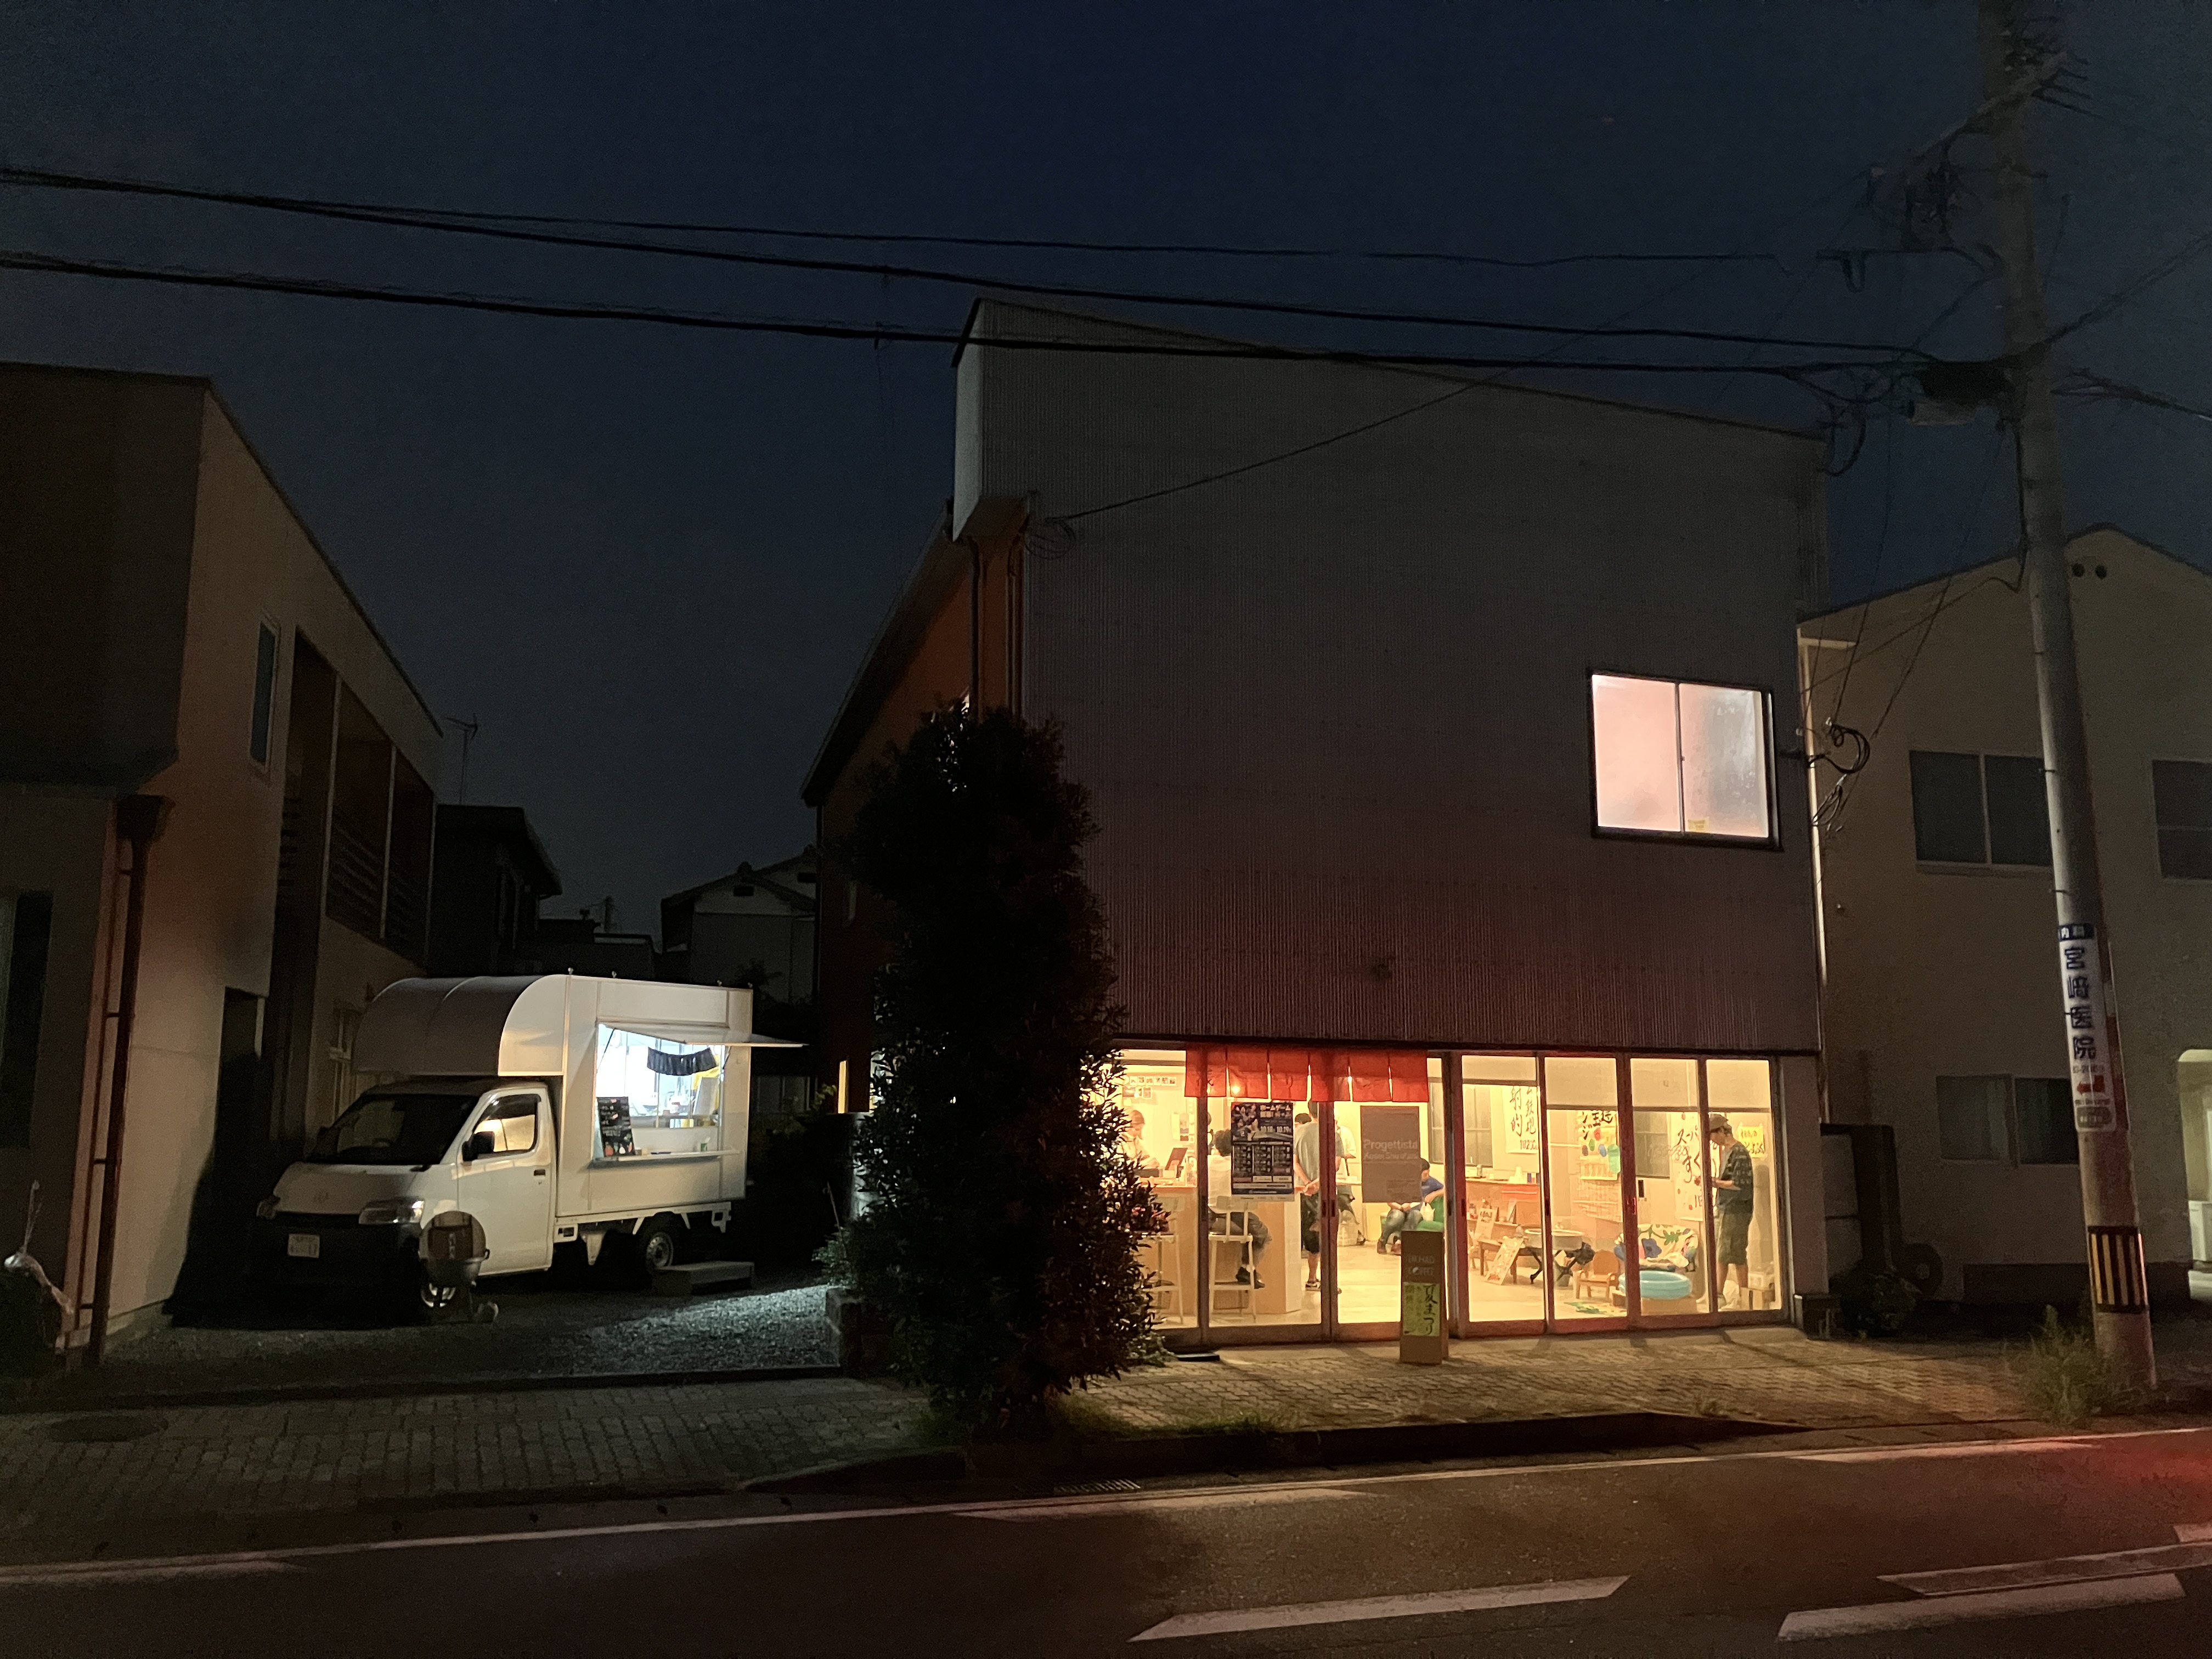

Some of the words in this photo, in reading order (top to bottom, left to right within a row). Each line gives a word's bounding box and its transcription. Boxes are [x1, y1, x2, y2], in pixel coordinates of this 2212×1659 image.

[1363, 1138, 1418, 1152] Progettista
[1423, 1284, 1438, 1335] 夏まつり
